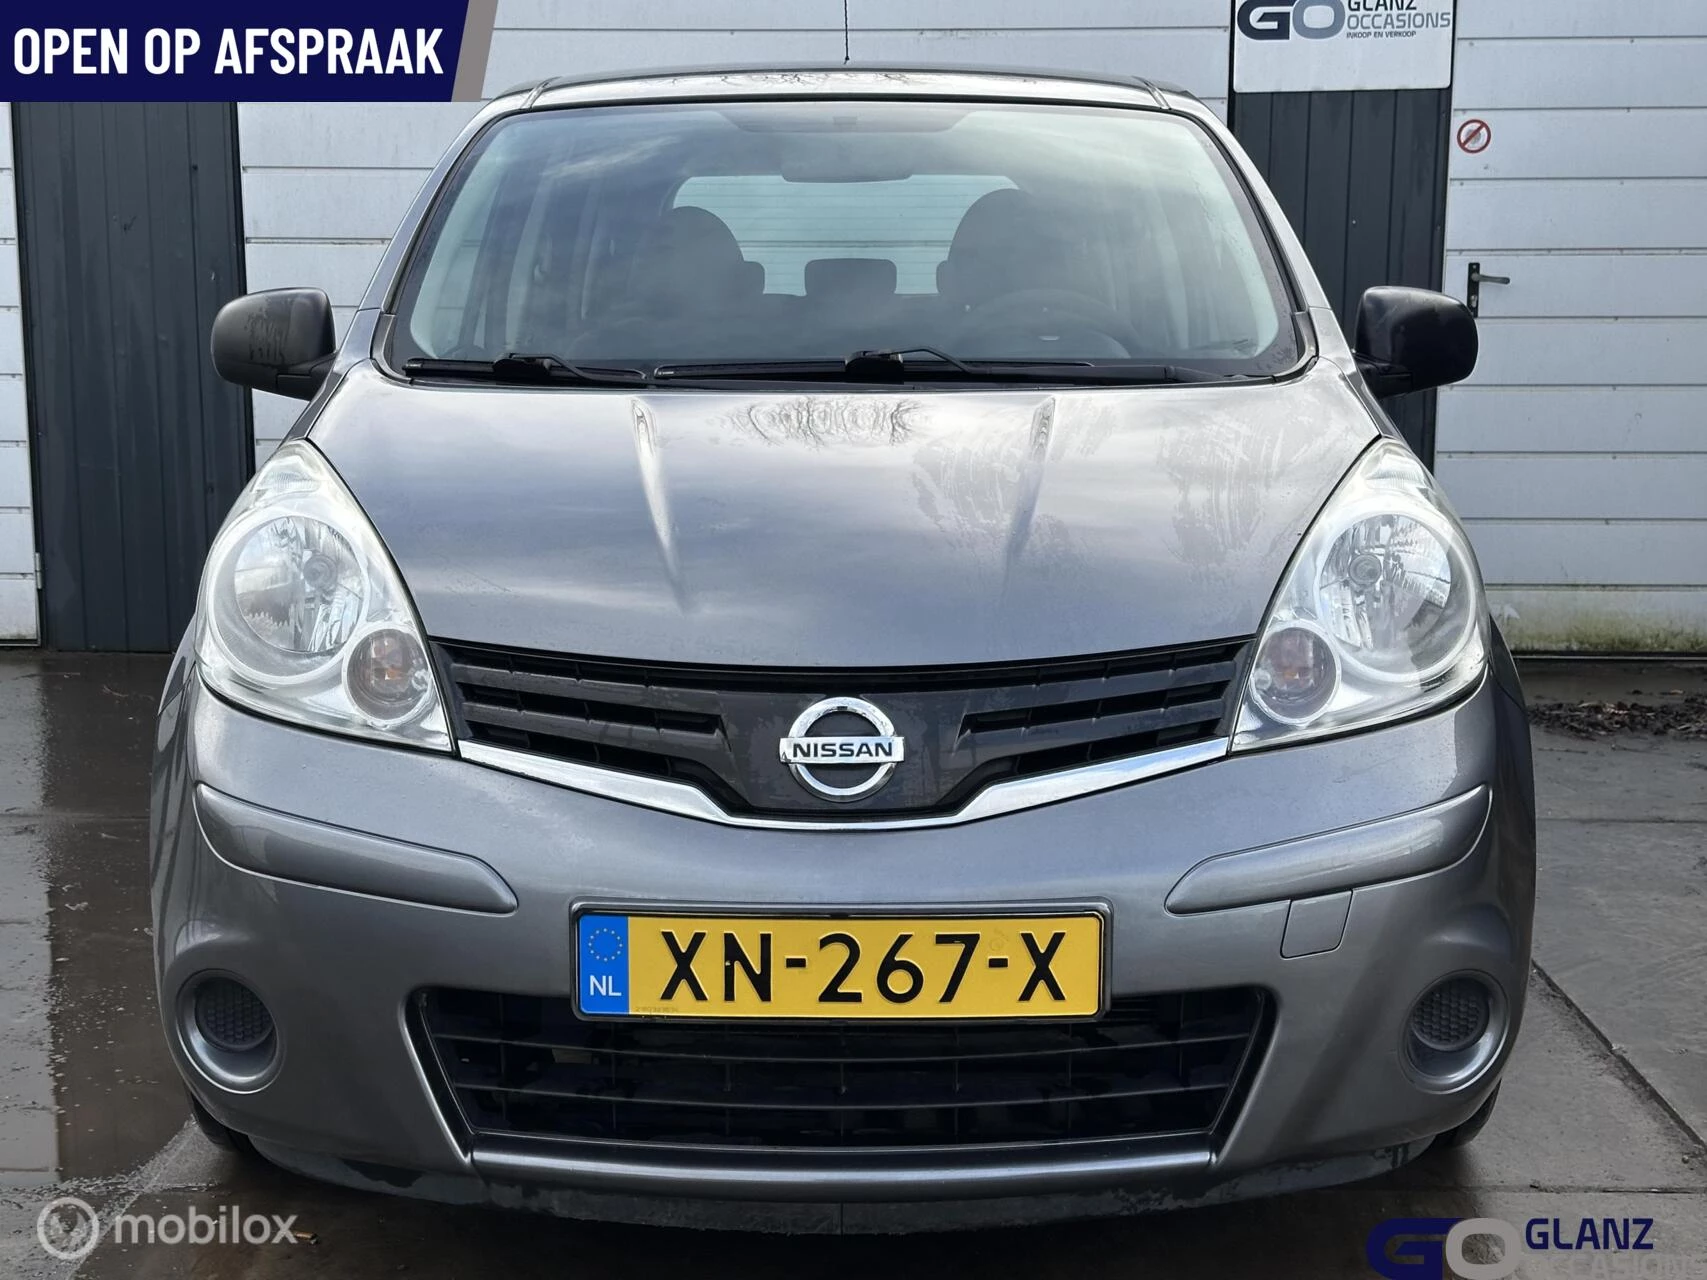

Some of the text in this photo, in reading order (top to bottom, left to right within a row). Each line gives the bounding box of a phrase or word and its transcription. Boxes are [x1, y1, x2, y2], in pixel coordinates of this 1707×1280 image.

[1347, 12, 1451, 30] OCCASIONS
[1346, 31, 1372, 39] INKOOP
[1385, 30, 1417, 38] VERKOOP
[793, 742, 893, 758] NISSAN
[660, 930, 1067, 1004] XN-267-X
[589, 975, 622, 996] NL
